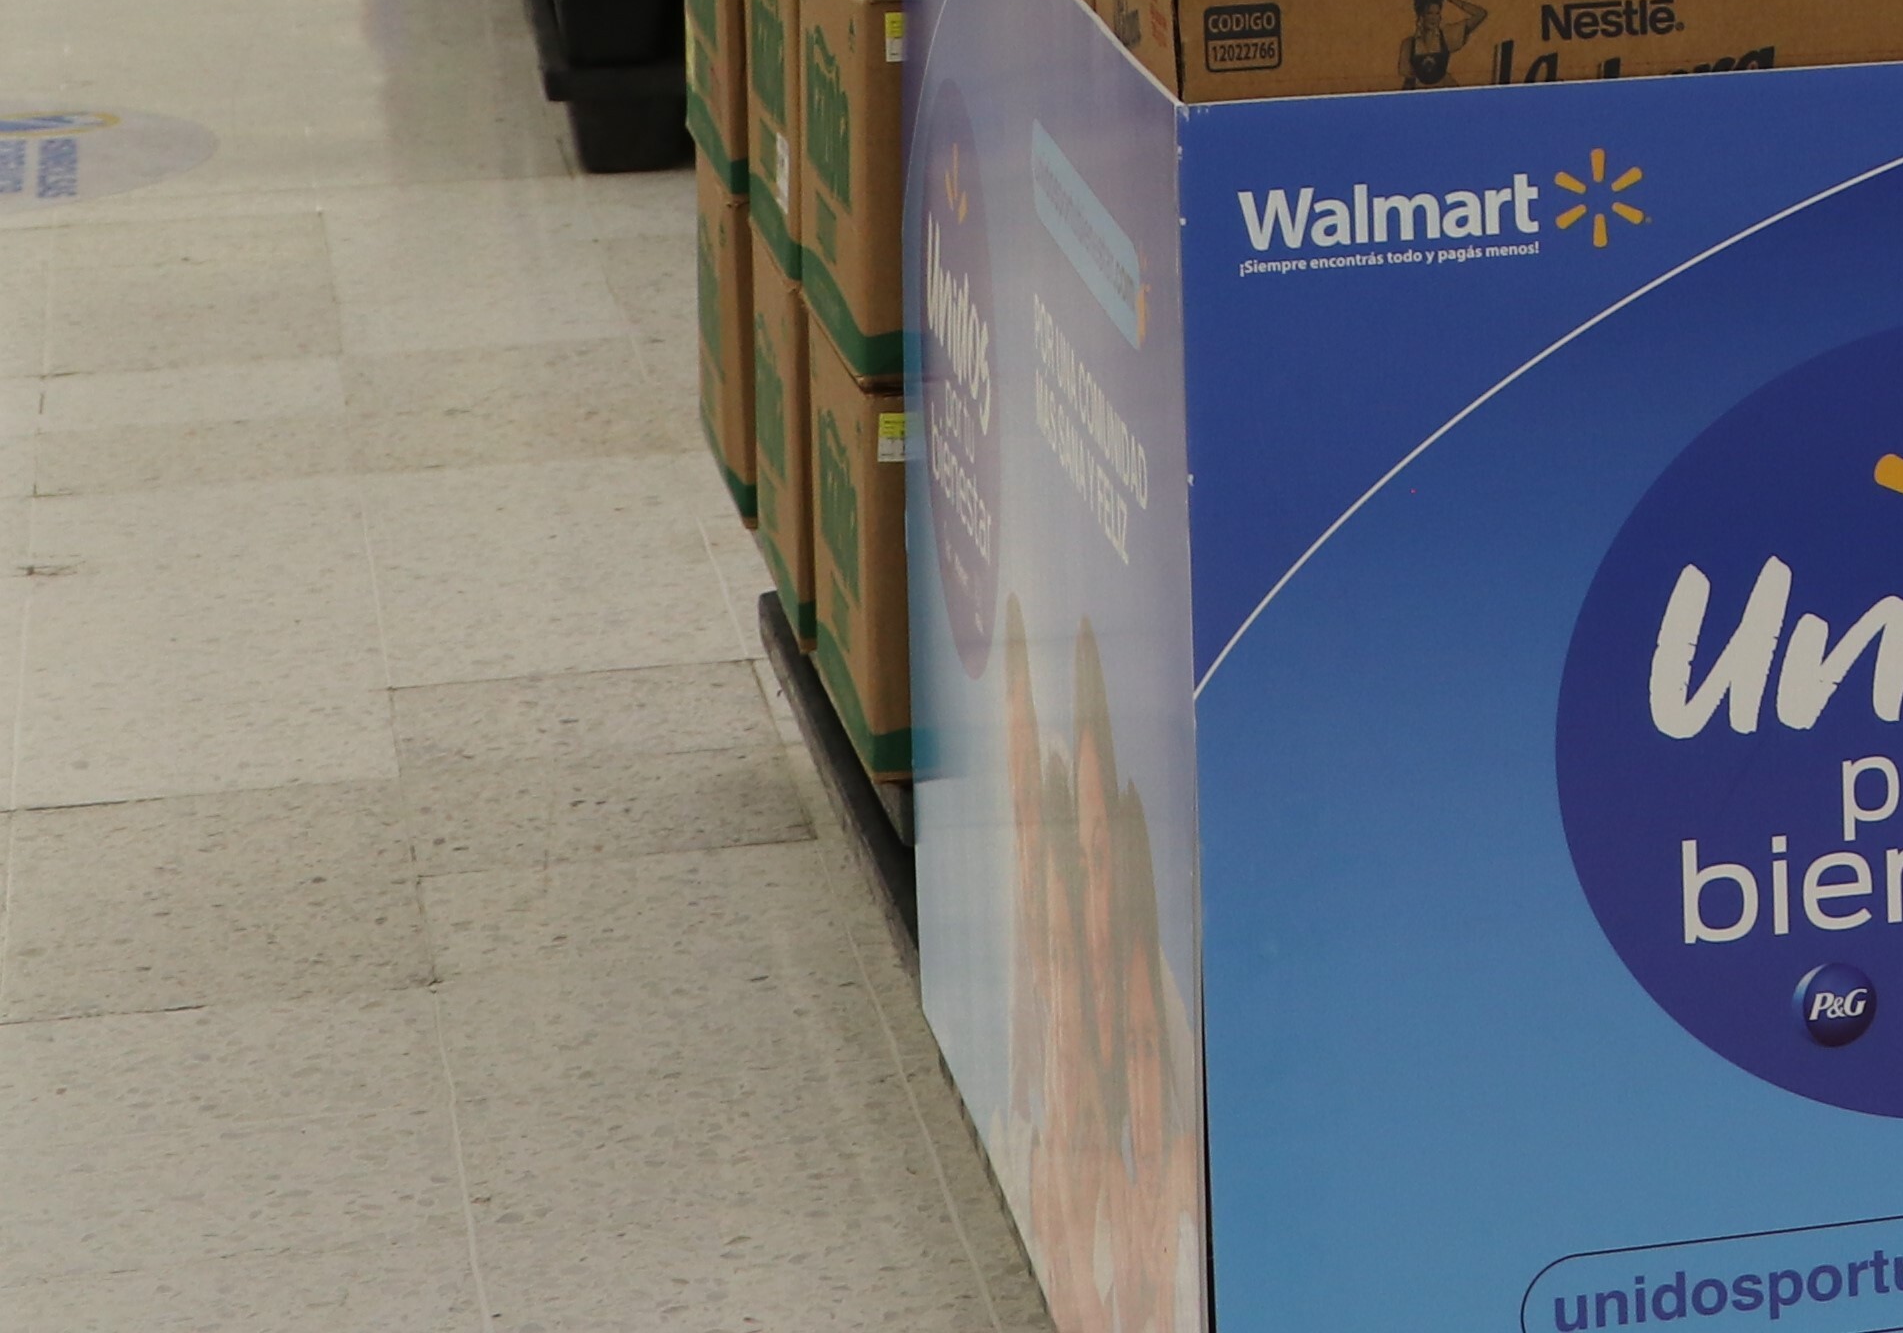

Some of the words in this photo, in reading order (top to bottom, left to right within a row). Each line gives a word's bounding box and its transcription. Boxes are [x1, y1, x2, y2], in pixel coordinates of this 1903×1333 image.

[1206, 10, 1277, 35] CODIGO
[1210, 39, 1276, 64] 12022766
[1238, 174, 1541, 255] Walmart
[1239, 255, 1306, 277] ¡Siempre
[1310, 250, 1383, 271] encontrás
[1386, 249, 1420, 265] todo
[1424, 251, 1433, 266] y
[1437, 245, 1483, 264] pagás
[1486, 241, 1540, 261] menos!
[1809, 988, 1868, 1021] P&G
